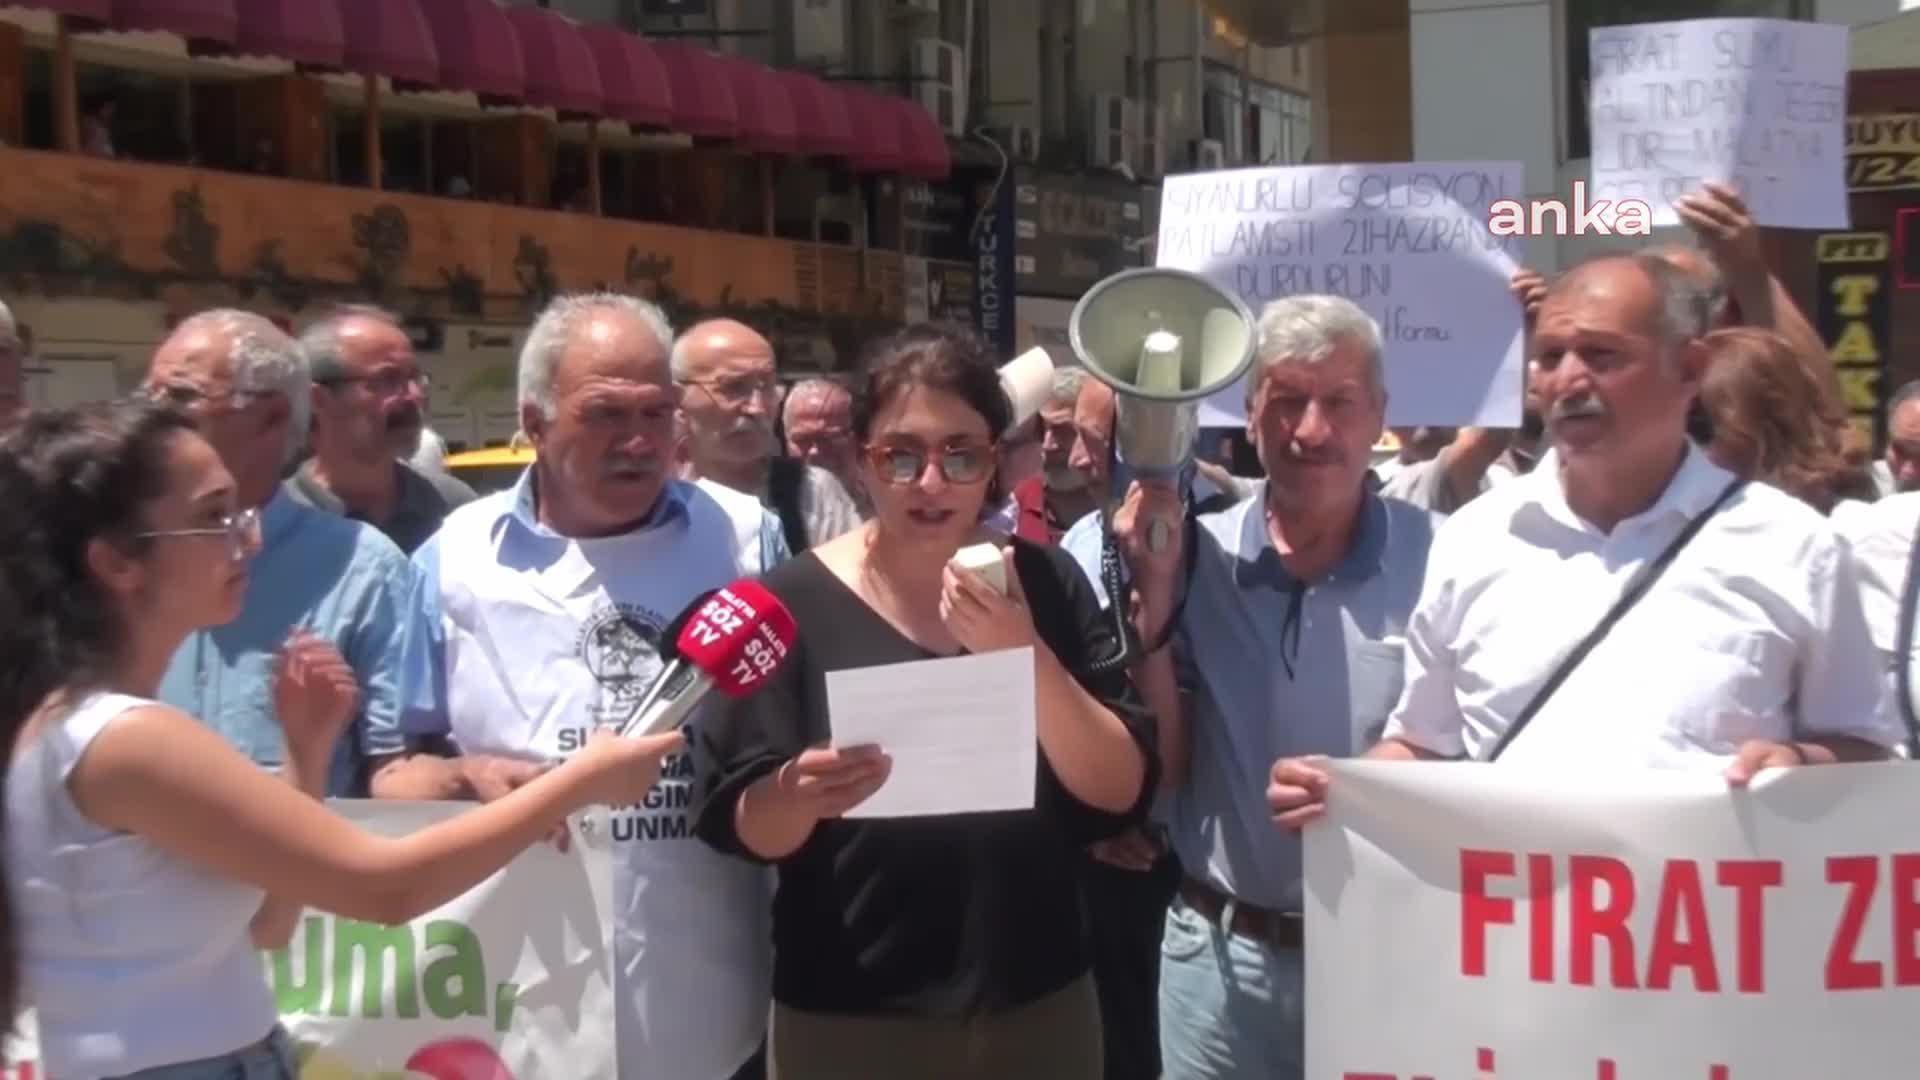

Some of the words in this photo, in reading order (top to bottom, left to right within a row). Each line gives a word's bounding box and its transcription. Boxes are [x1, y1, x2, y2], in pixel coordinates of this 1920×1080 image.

[701, 600, 743, 635] SÖZ
[690, 620, 721, 646] TV
[730, 659, 757, 685] TV
[1459, 847, 1784, 994] FIRAT
